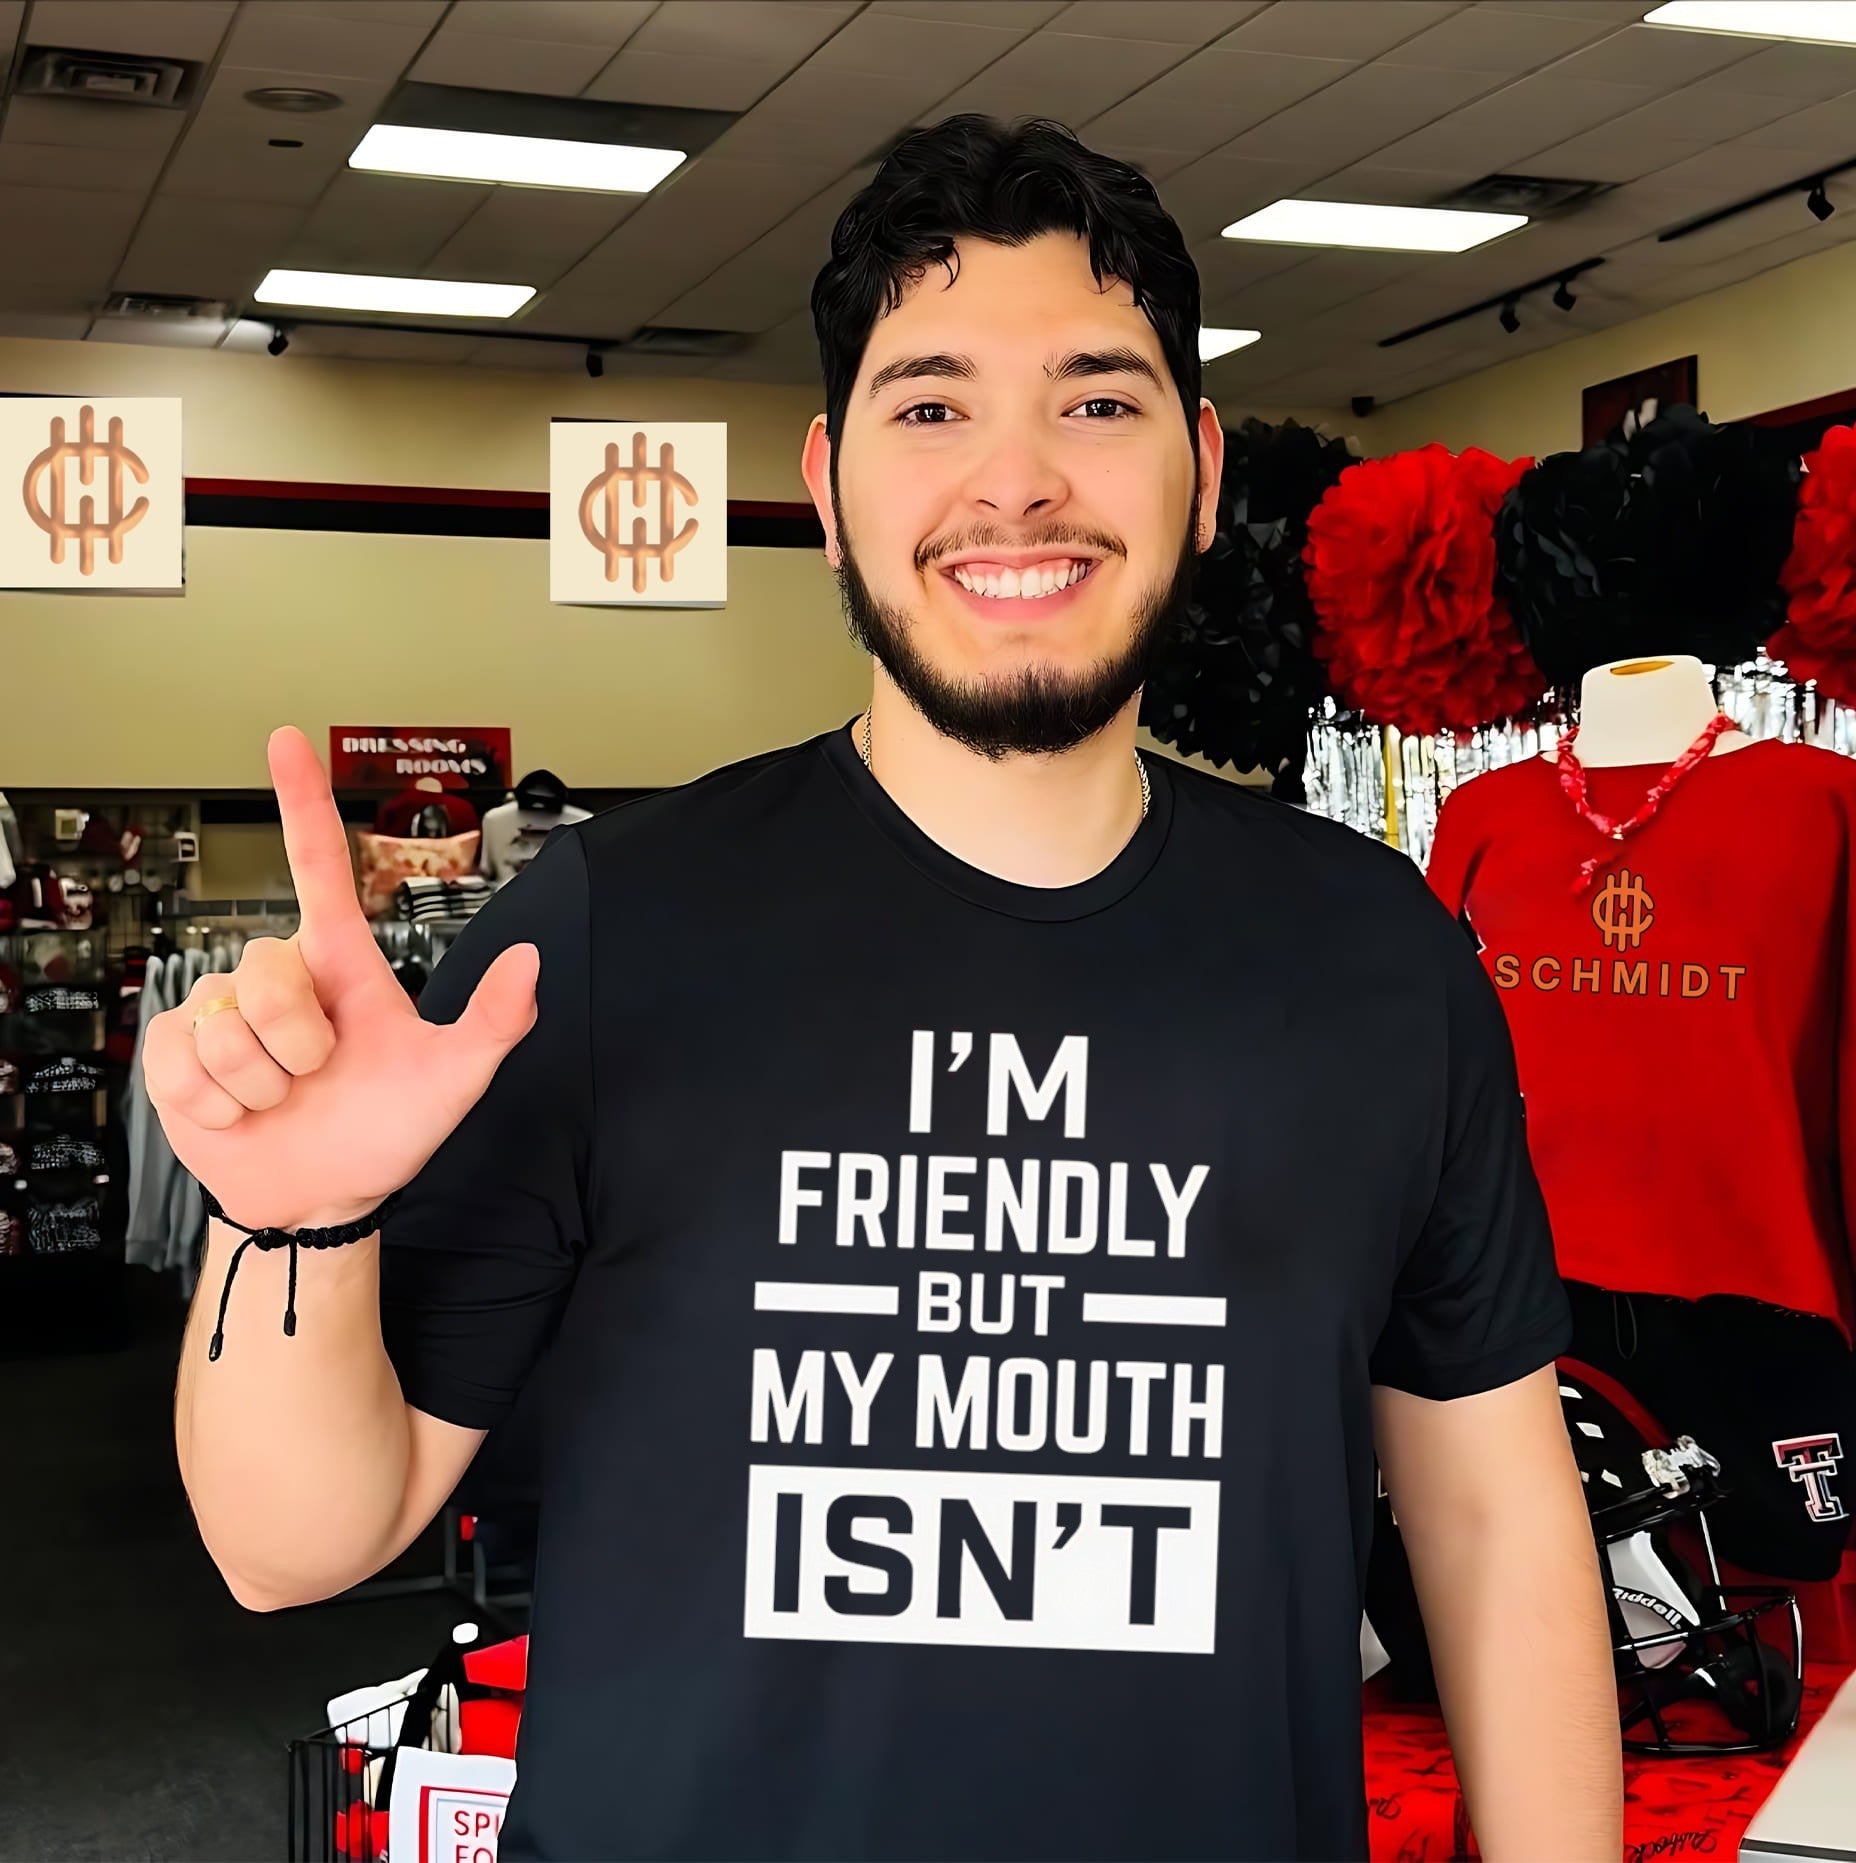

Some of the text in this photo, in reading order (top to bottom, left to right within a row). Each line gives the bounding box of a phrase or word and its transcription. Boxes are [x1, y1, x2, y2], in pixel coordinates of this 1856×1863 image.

[341, 737, 467, 754] DRESSING
[395, 758, 487, 775] ROOMS
[1494, 953, 1747, 1001] SCHMIDT
[909, 1029, 1090, 1139] I'M
[778, 1150, 1211, 1259] FRIENDLY
[917, 1270, 1066, 1337] BUT
[750, 1348, 1225, 1459] MY MOUTH
[772, 1491, 1193, 1627] ISN'T
